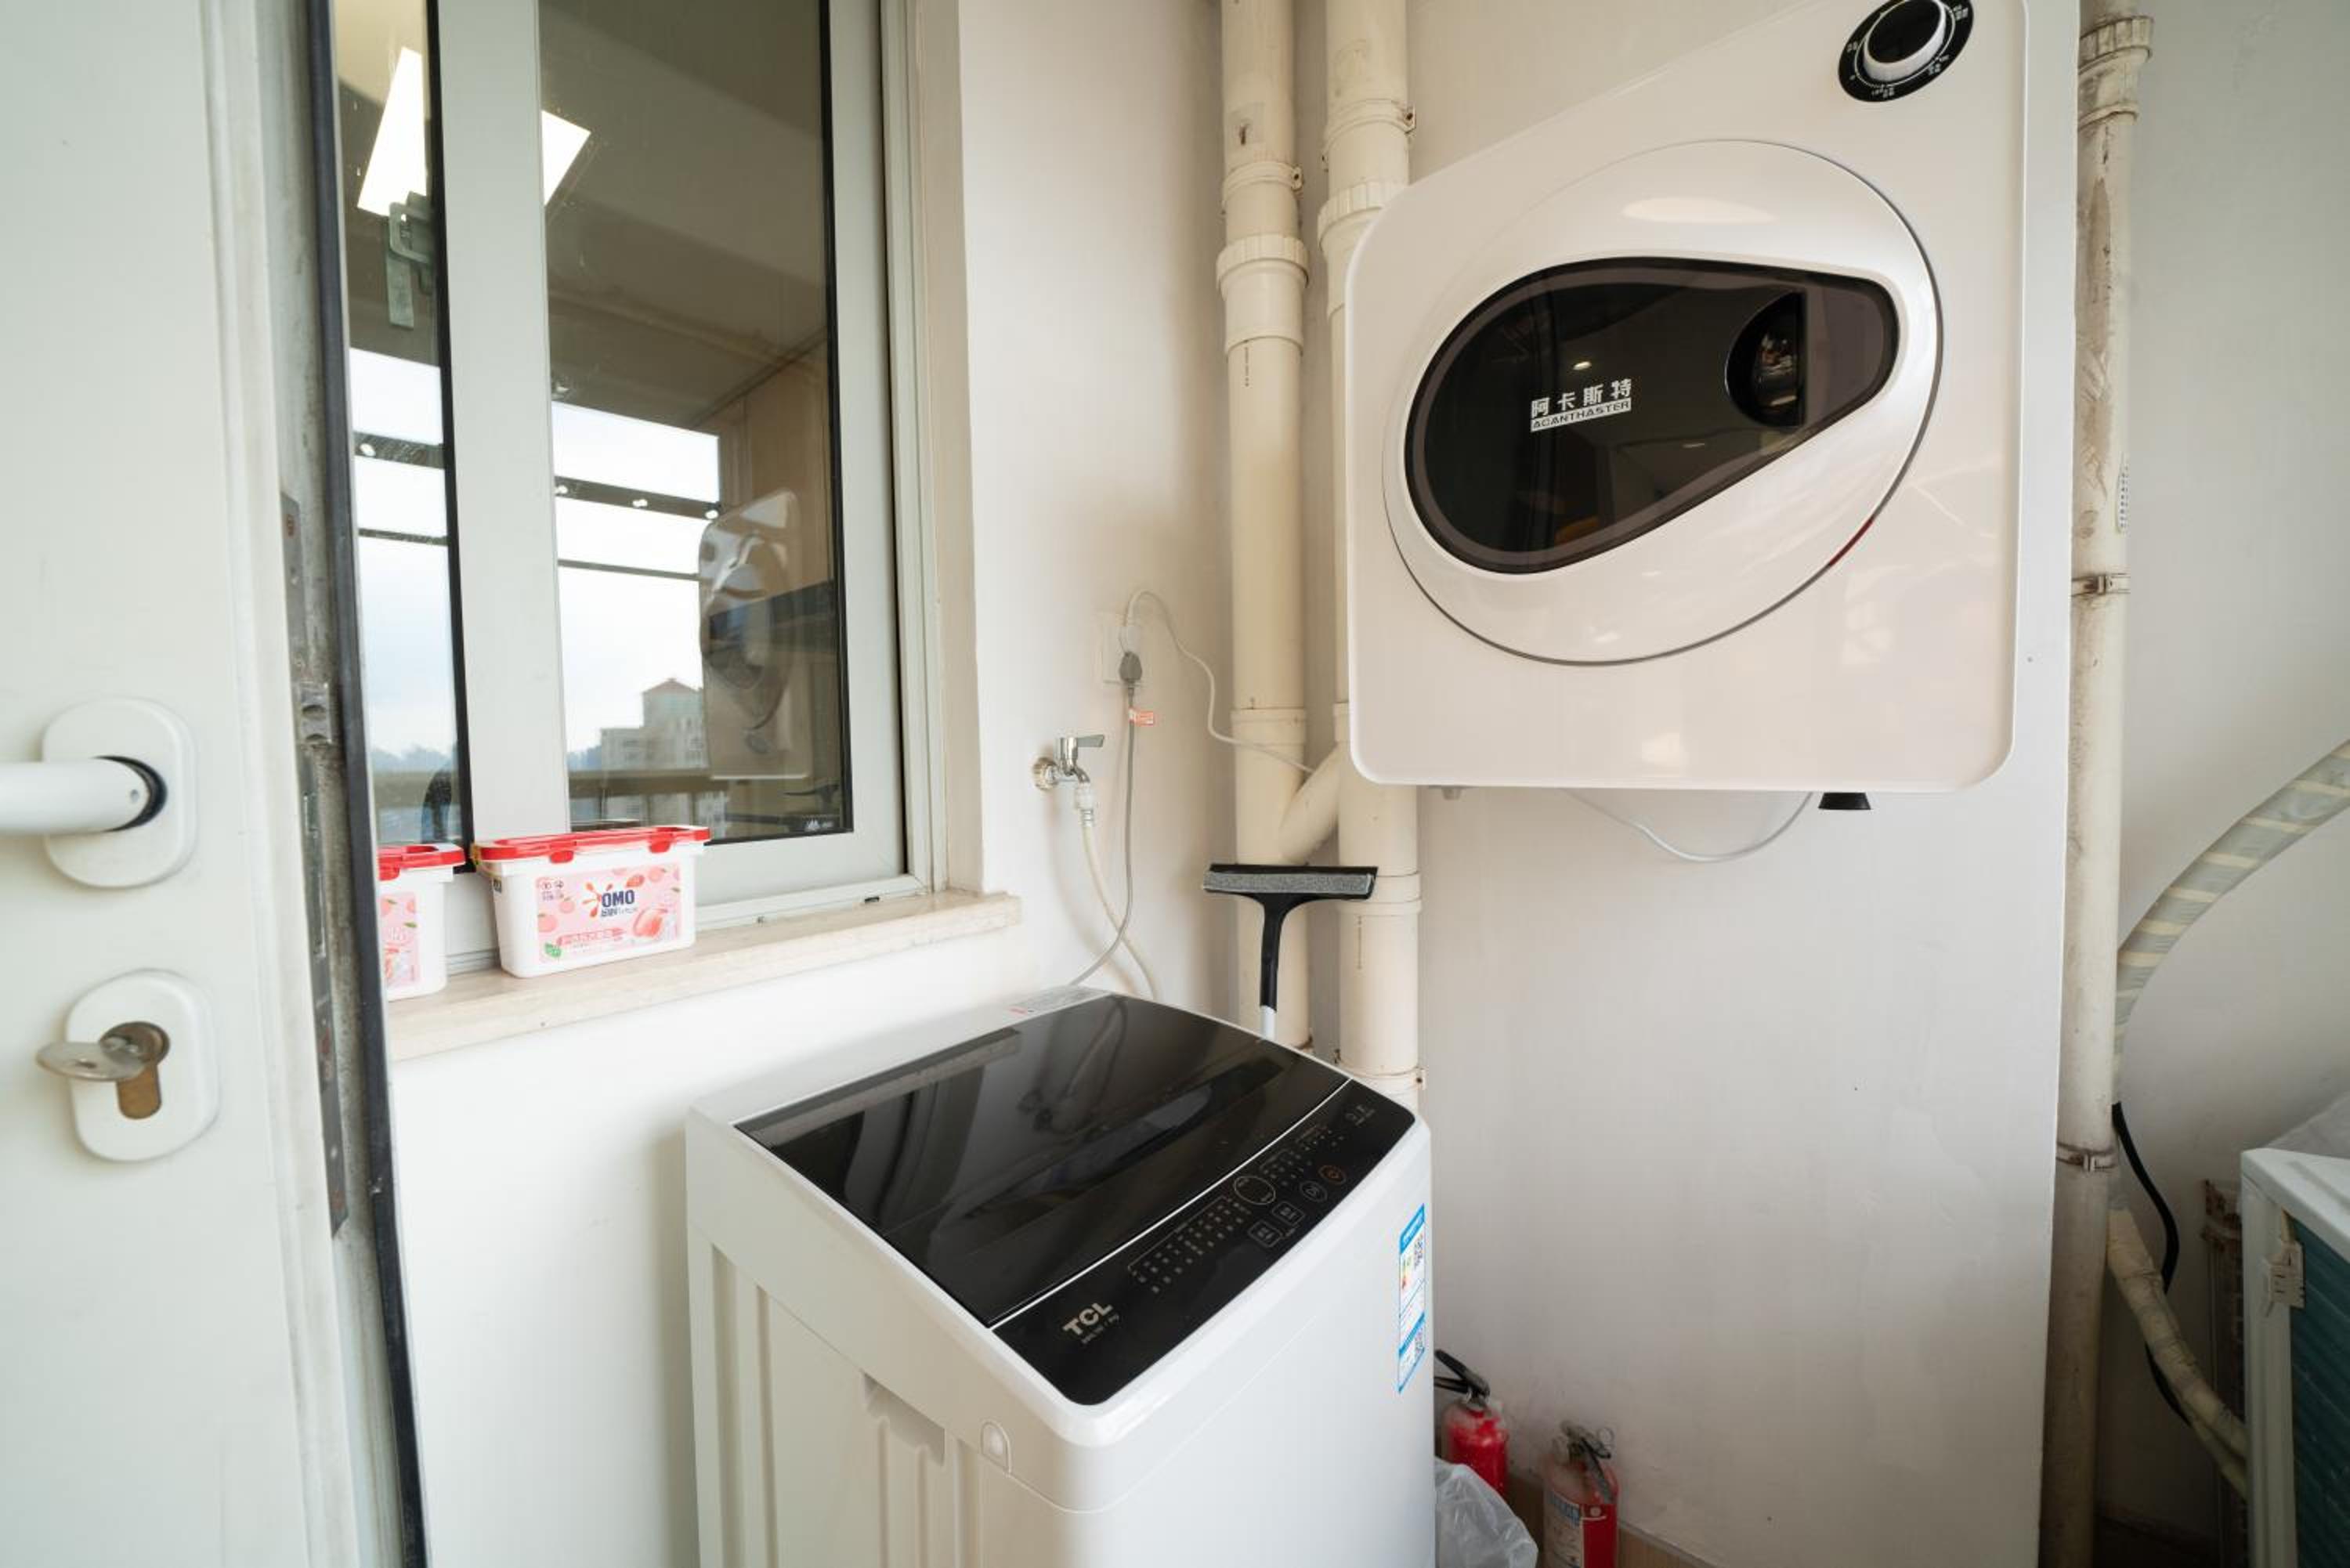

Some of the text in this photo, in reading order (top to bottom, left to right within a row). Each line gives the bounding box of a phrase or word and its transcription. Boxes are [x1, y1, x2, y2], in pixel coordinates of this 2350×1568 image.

[1532, 378, 1632, 417] 阿卡斯特
[1533, 400, 1629, 428] ACANTHASTER
[602, 889, 635, 908] OMO
[1062, 1302, 1113, 1335] TCL
